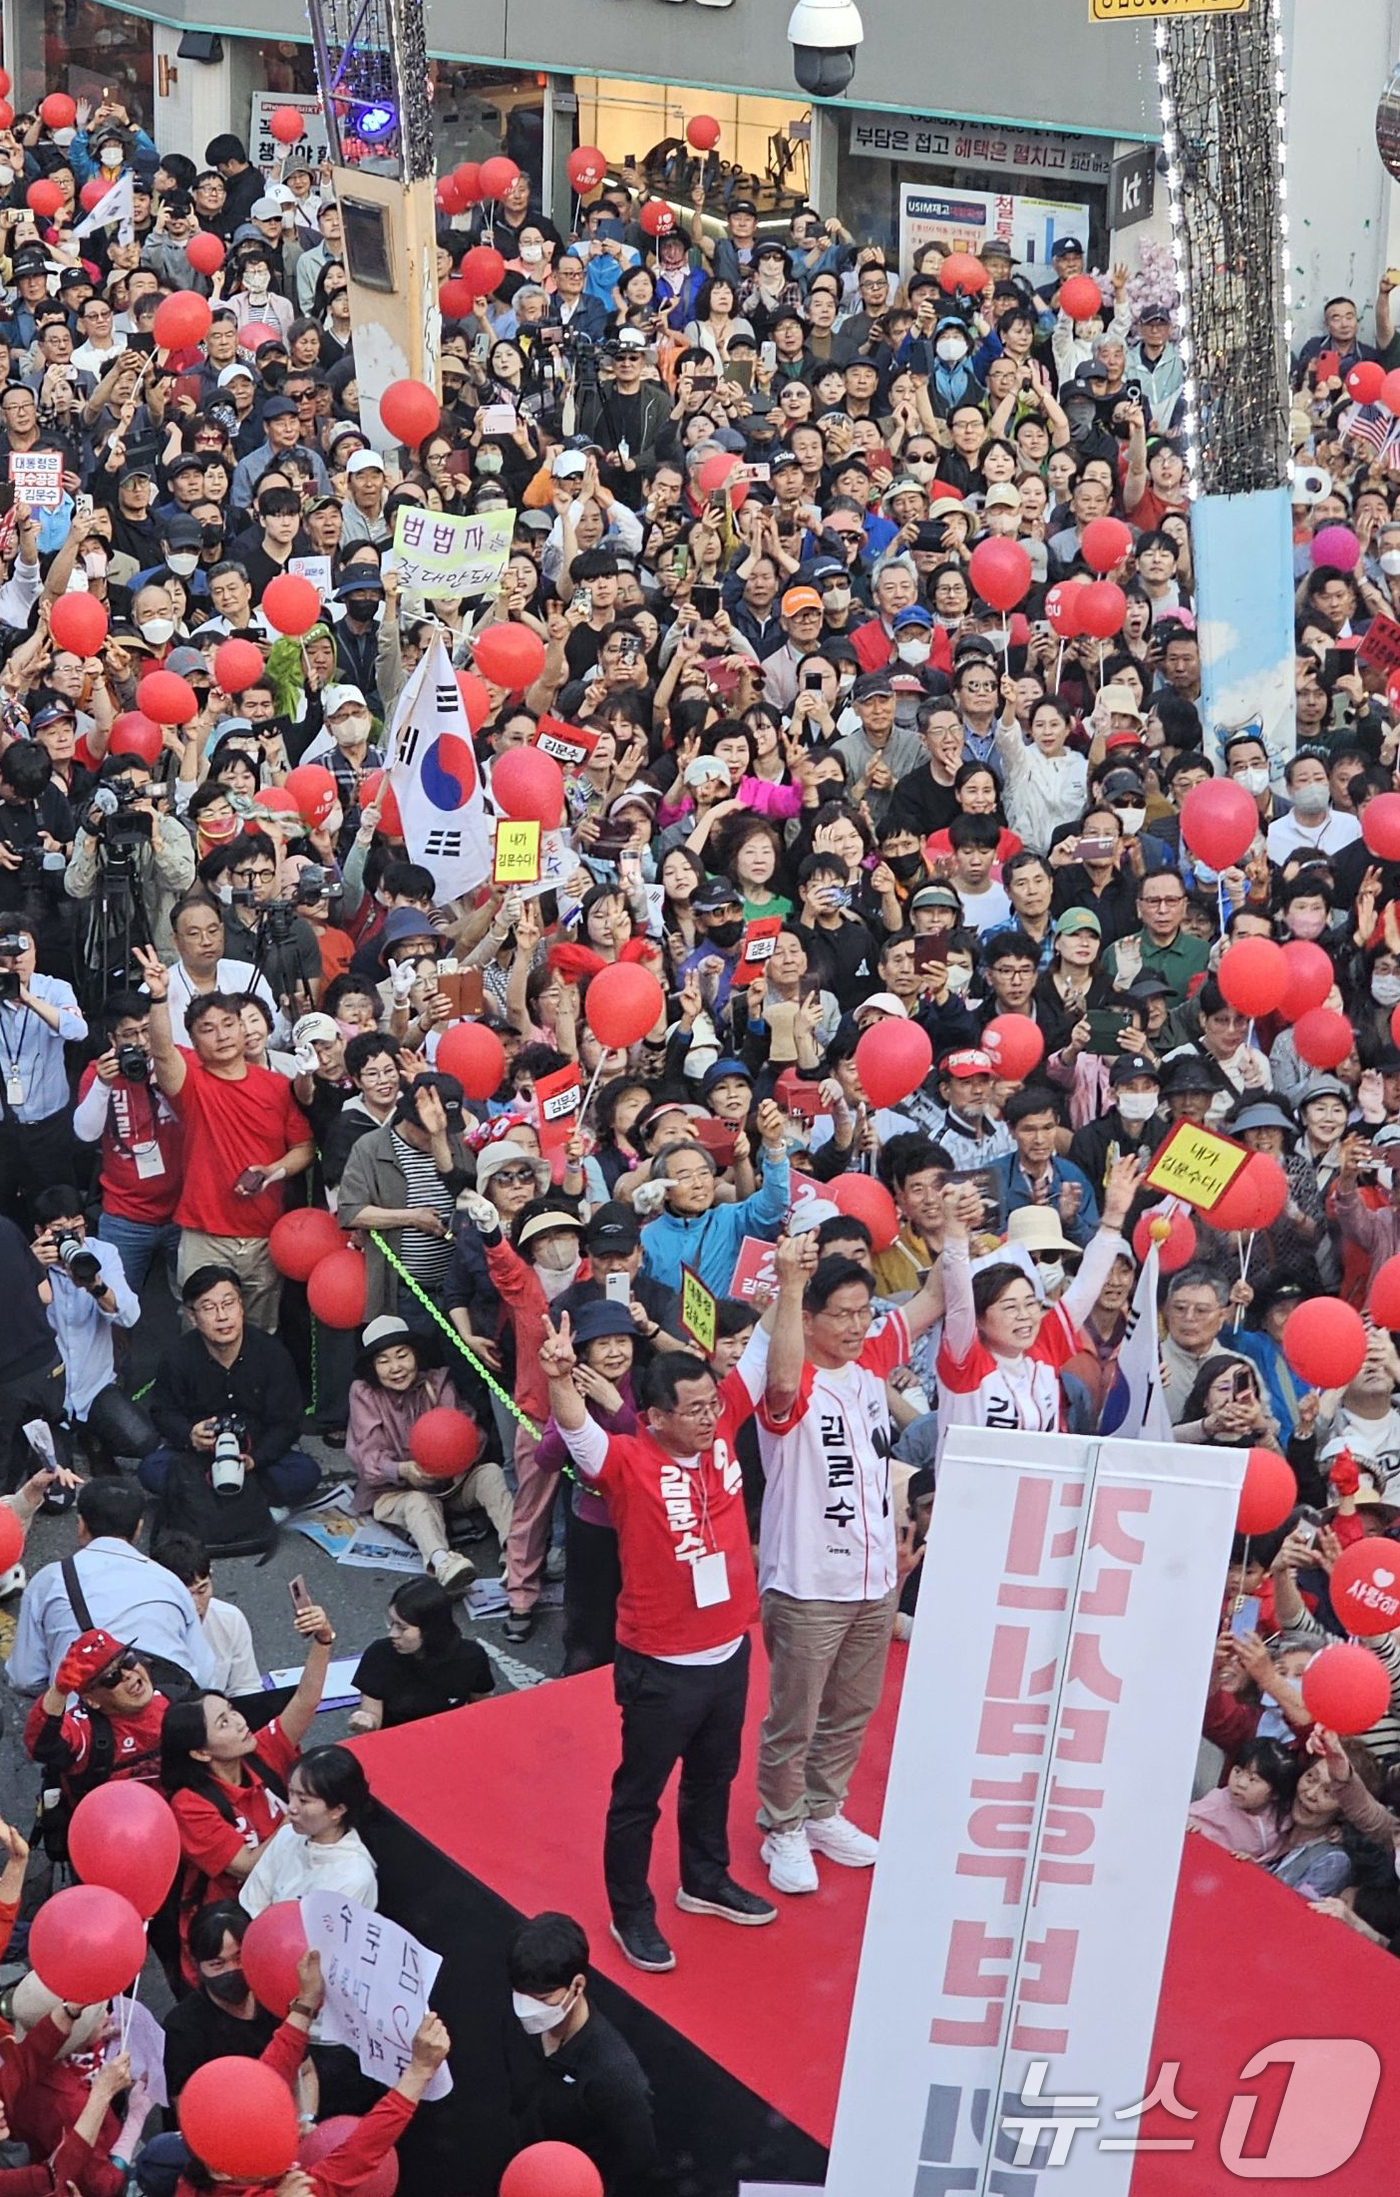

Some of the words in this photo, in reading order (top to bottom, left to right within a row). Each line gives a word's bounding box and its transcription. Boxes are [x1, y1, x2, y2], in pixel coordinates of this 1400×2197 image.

[857, 126, 909, 151] 부담은
[915, 132, 950, 155] 접고
[955, 137, 1008, 162] 혜택은
[1013, 144, 1066, 168] 펼치고
[1122, 171, 1142, 213] kt
[15, 457, 58, 470] 대통령은
[25, 489, 57, 502] 김문수
[403, 515, 505, 554] 범법자는
[544, 738, 579, 758] 김문수
[510, 833, 527, 846] 내가
[1190, 1143, 1221, 1167] 내가
[1161, 1156, 1223, 1194] 김문수다!
[821, 1415, 856, 1528] 김문수
[660, 1465, 708, 1566] 김문수
[1345, 1579, 1400, 1616] 사랑해
